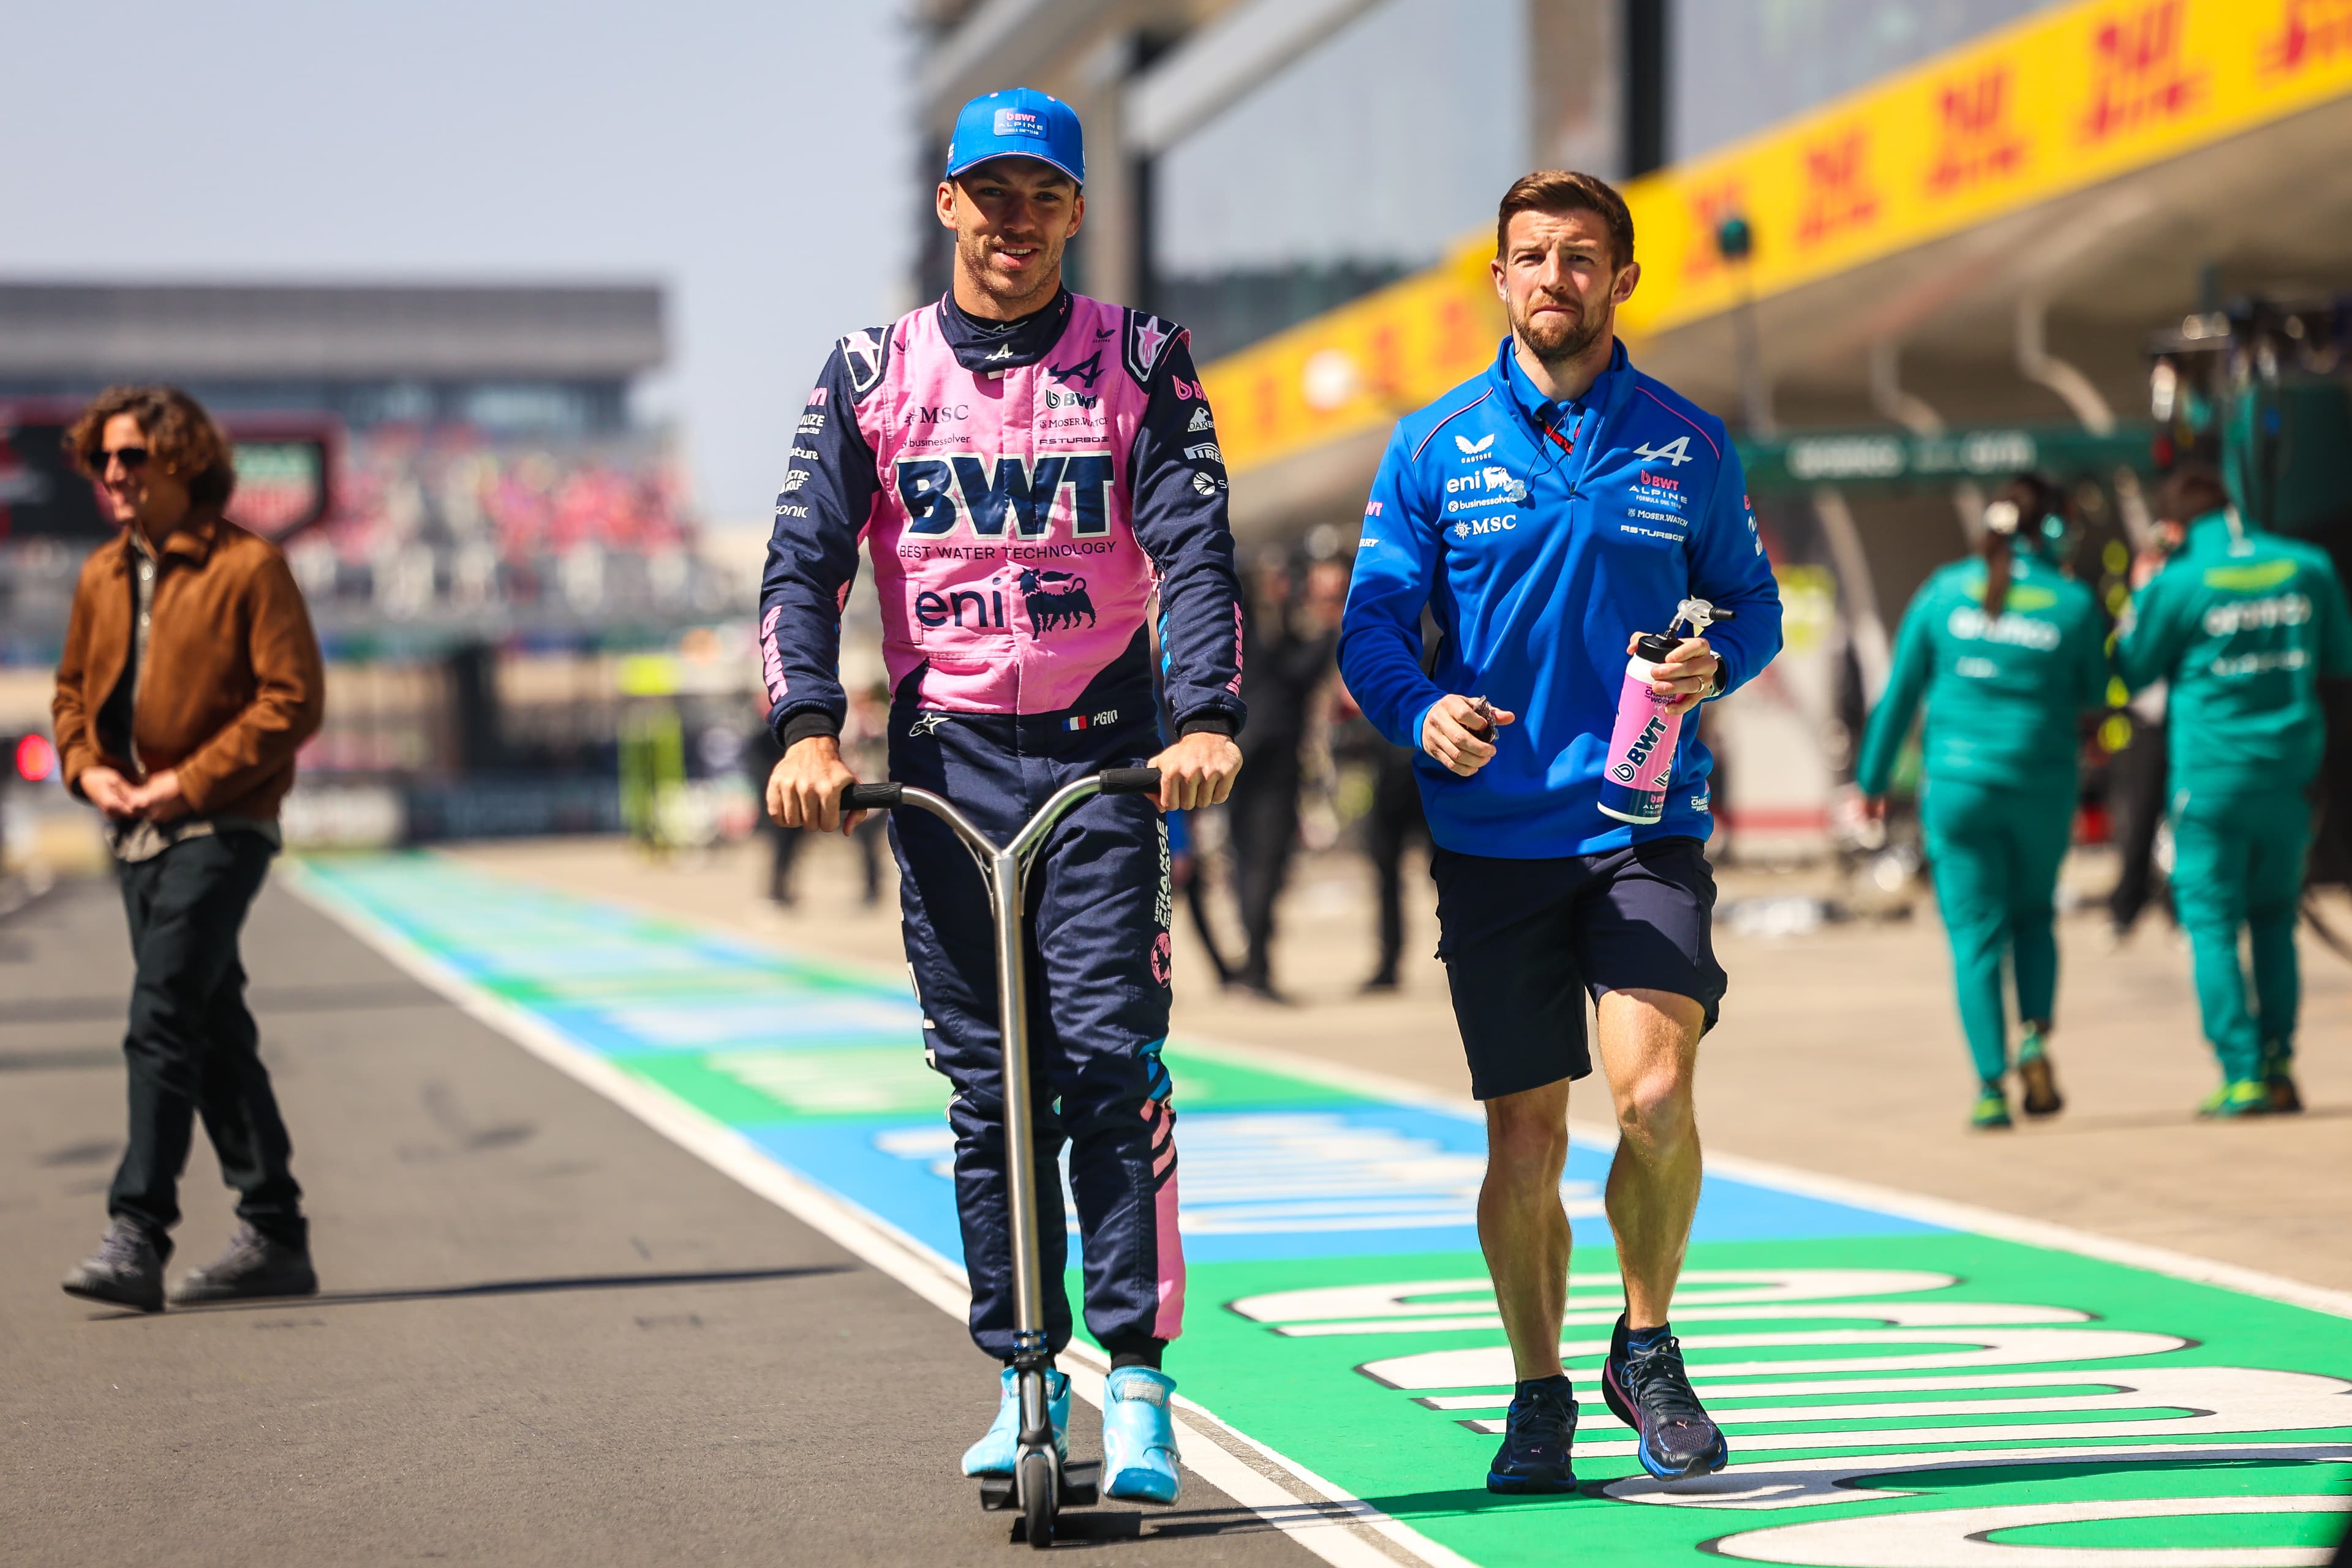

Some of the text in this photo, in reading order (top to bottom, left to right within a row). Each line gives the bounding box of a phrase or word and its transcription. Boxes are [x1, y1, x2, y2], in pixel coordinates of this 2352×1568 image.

[999, 121, 1043, 130] ALPINE
[1014, 113, 1036, 123] BWT
[1063, 391, 1098, 410] BWT
[919, 404, 969, 424] MSC
[909, 433, 971, 448] businessolver
[1461, 452, 1492, 464] CASTORE
[1446, 470, 1480, 493] eni
[1652, 476, 1679, 491] BWT
[894, 450, 1116, 541] BWT
[1460, 494, 1514, 510] businessolve
[1629, 484, 1688, 504] ALPINE
[1471, 514, 1517, 536] MSC
[900, 541, 1118, 560] BEST WATER TECHNOLOGY
[915, 577, 1005, 628] eni
[1624, 714, 1668, 769] BWT
[1156, 818, 1169, 928] CHANGE
